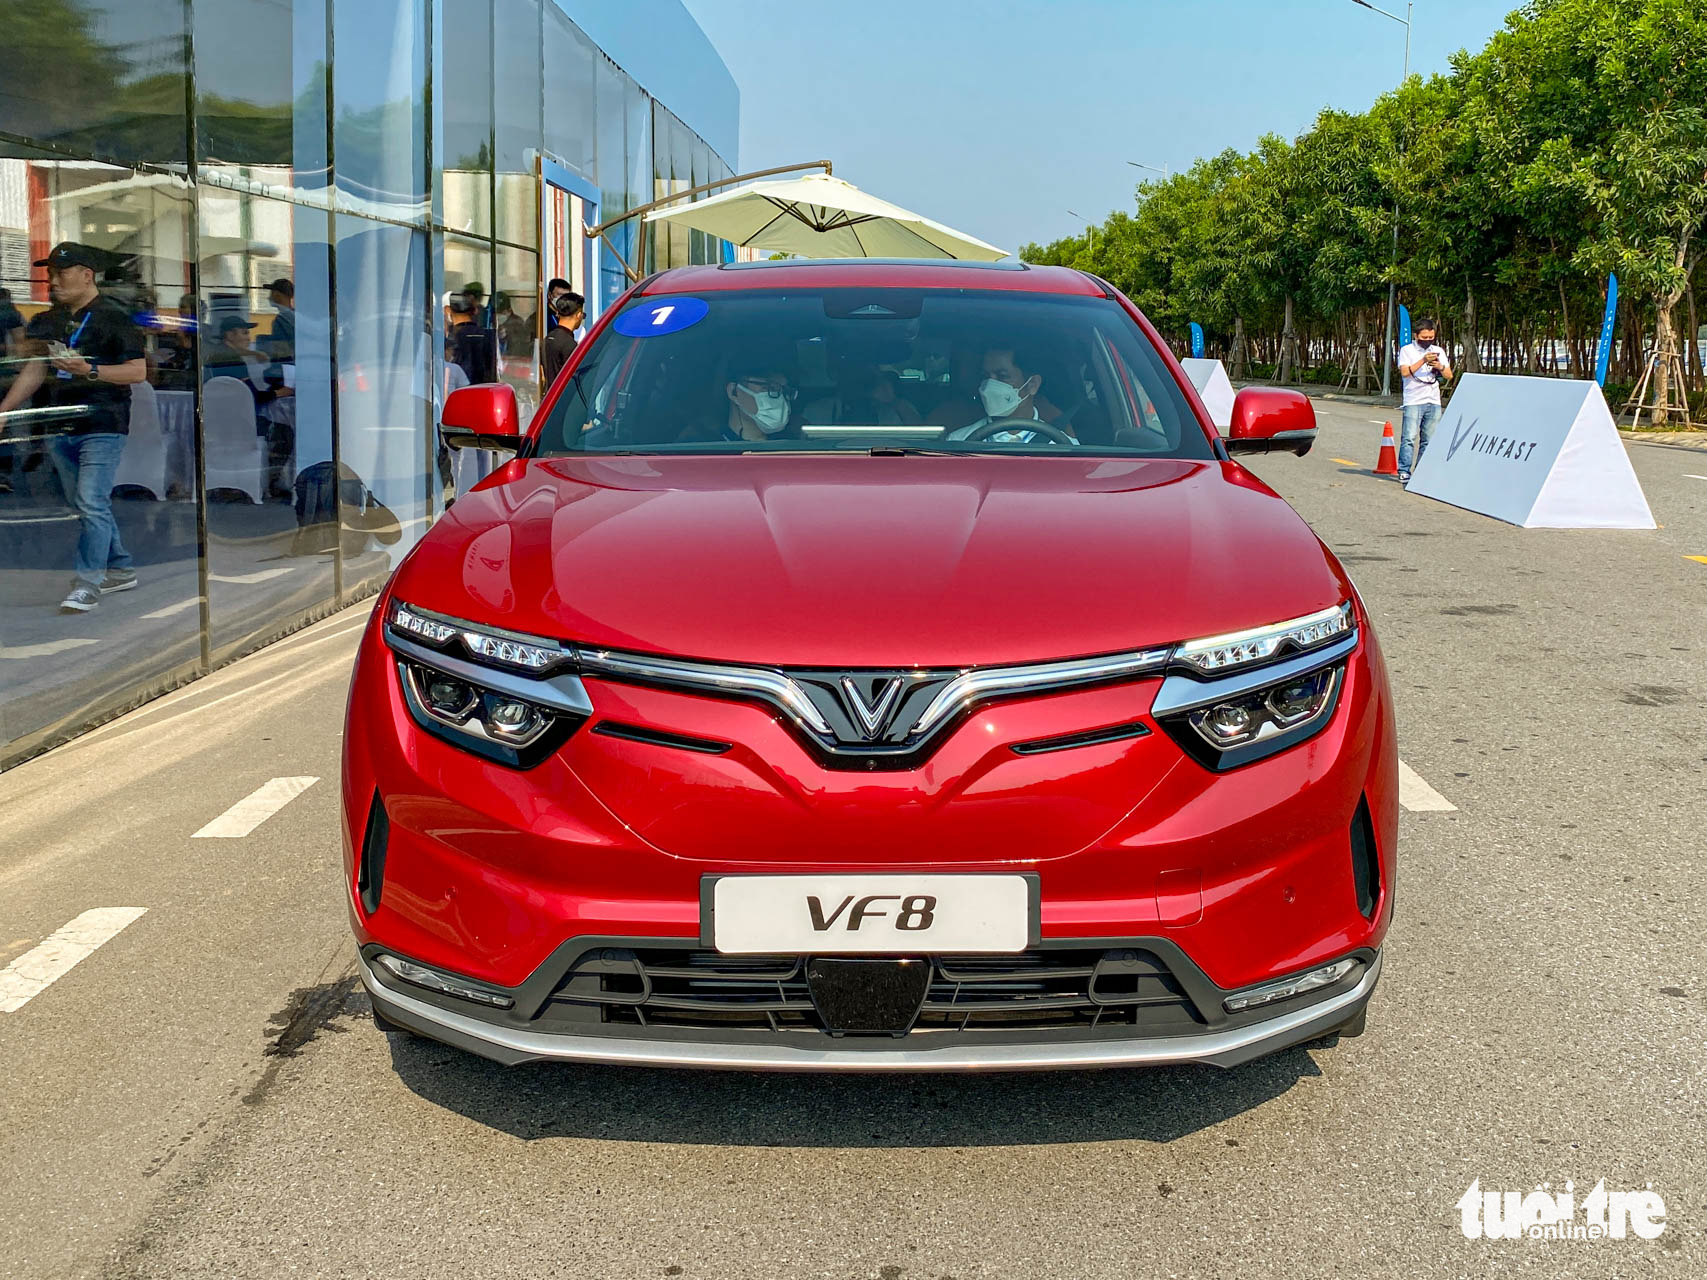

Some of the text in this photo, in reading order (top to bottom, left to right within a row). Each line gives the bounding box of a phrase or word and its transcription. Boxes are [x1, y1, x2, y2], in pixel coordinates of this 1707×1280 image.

[651, 306, 675, 325] 1
[1470, 433, 1537, 462] VINFAST
[806, 895, 937, 932] VF8
